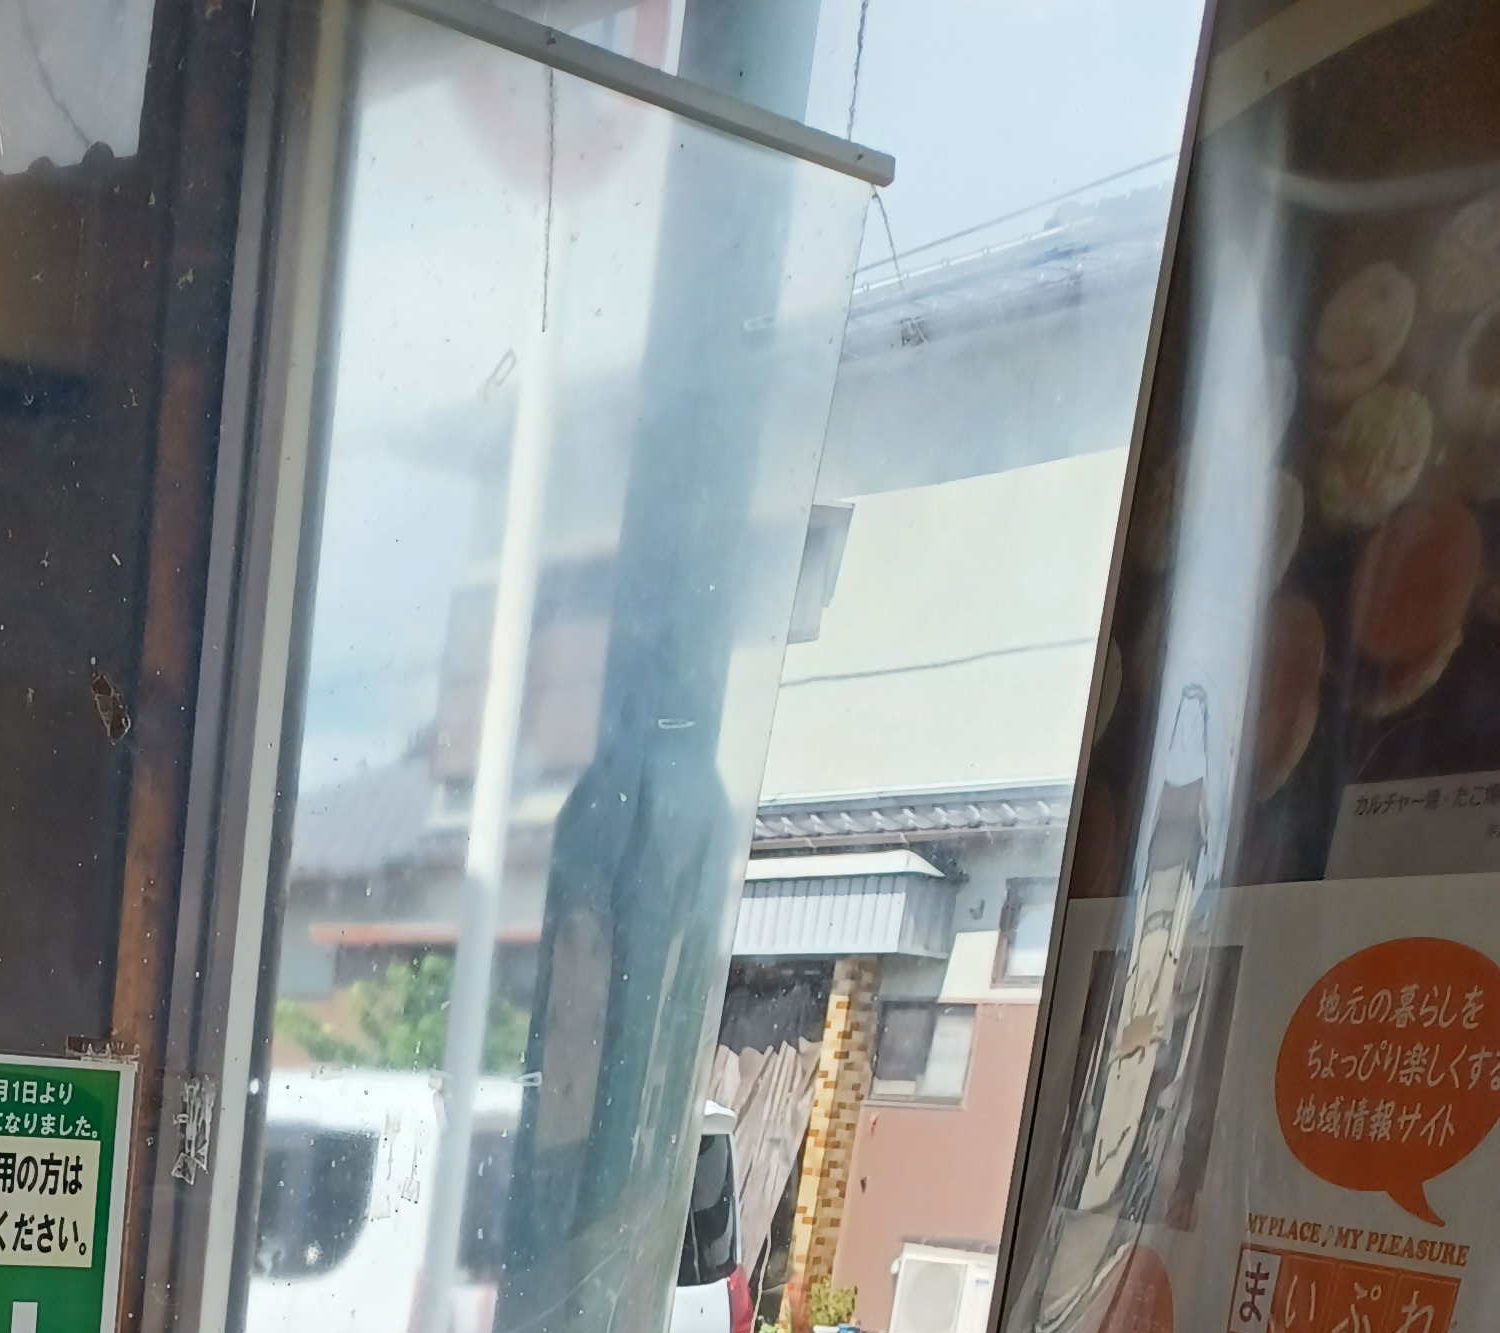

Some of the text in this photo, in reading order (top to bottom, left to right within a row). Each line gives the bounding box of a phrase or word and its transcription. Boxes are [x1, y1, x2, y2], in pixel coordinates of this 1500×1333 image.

[1316, 983, 1484, 1030] 地元の暮らしを
[1293, 1093, 1455, 1148] 地域情報サイト
[1266, 1216, 1321, 1244] PLACE
[1334, 1226, 1365, 1250] MY
[1365, 1231, 1470, 1267] PLEASURE
